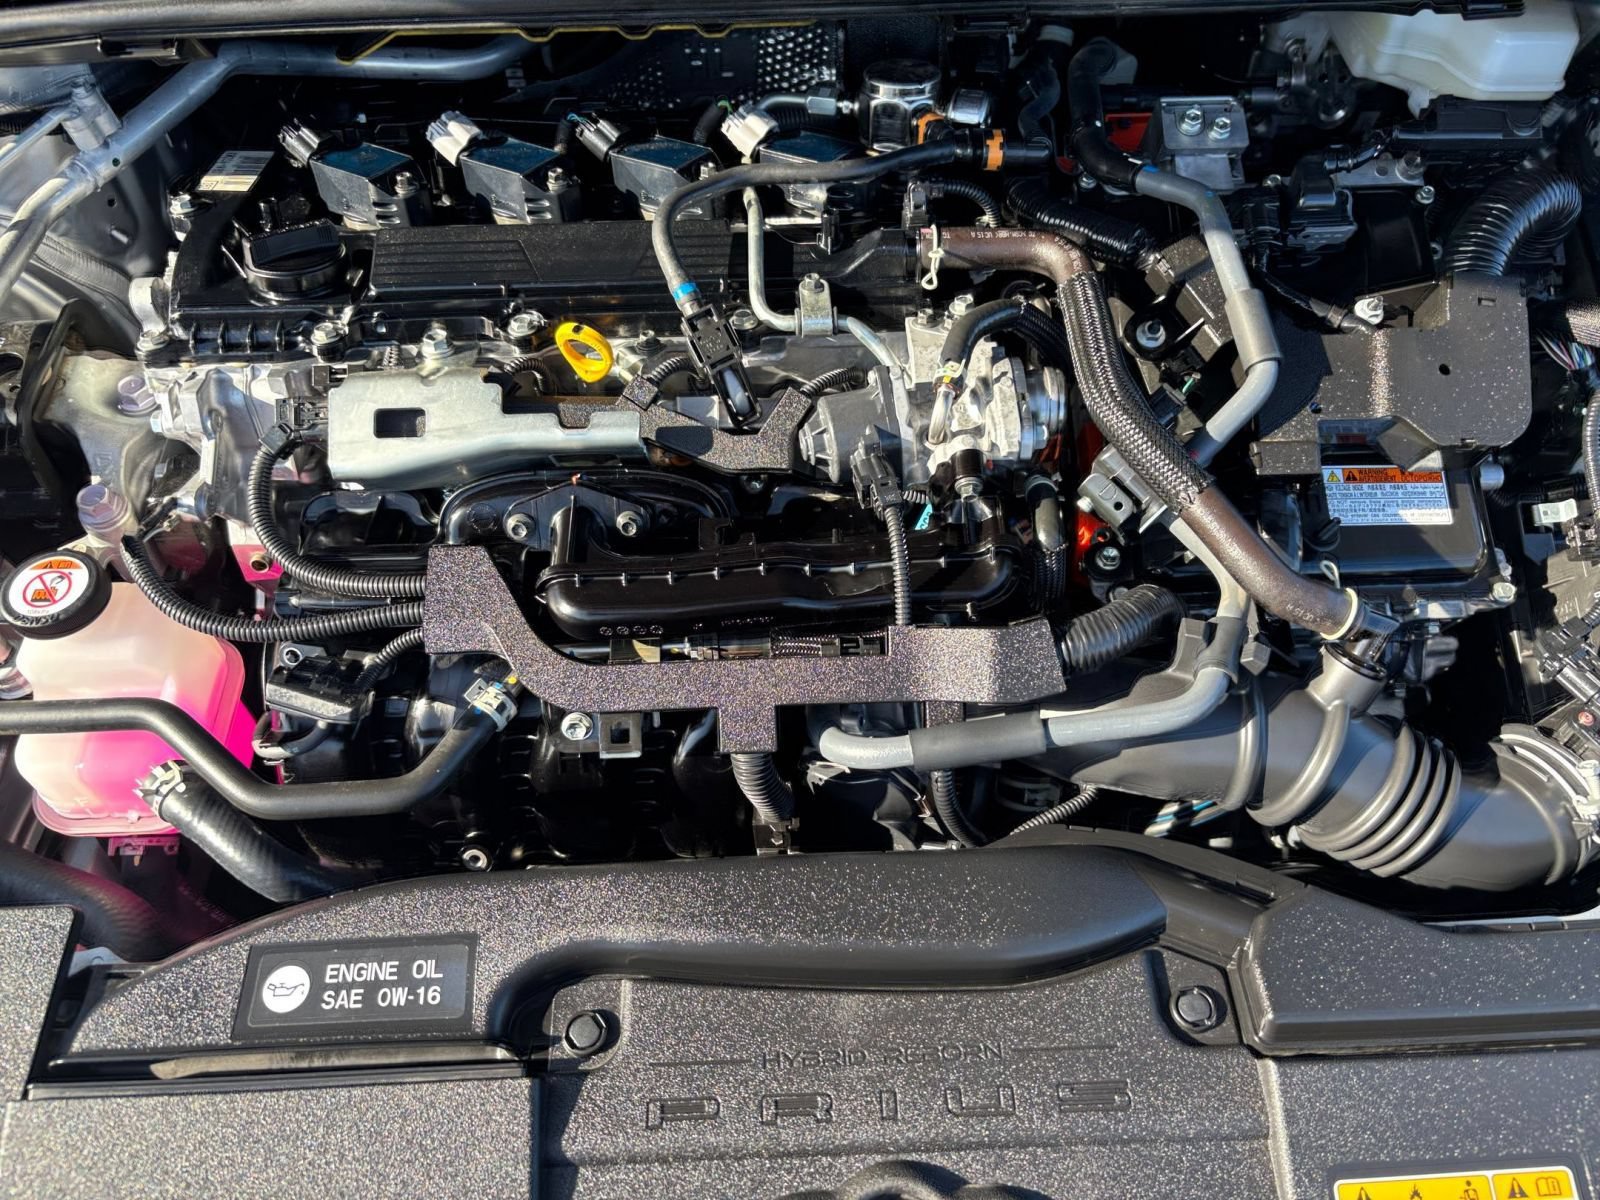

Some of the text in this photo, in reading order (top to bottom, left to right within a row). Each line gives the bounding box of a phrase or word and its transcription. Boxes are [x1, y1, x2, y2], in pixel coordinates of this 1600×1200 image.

[324, 959, 443, 984] ENGINE OIL
[320, 985, 441, 1010] SAE 0W-16
[762, 1042, 1004, 1070] HYBRID REBORN
[646, 1078, 1131, 1131] PRIUS
